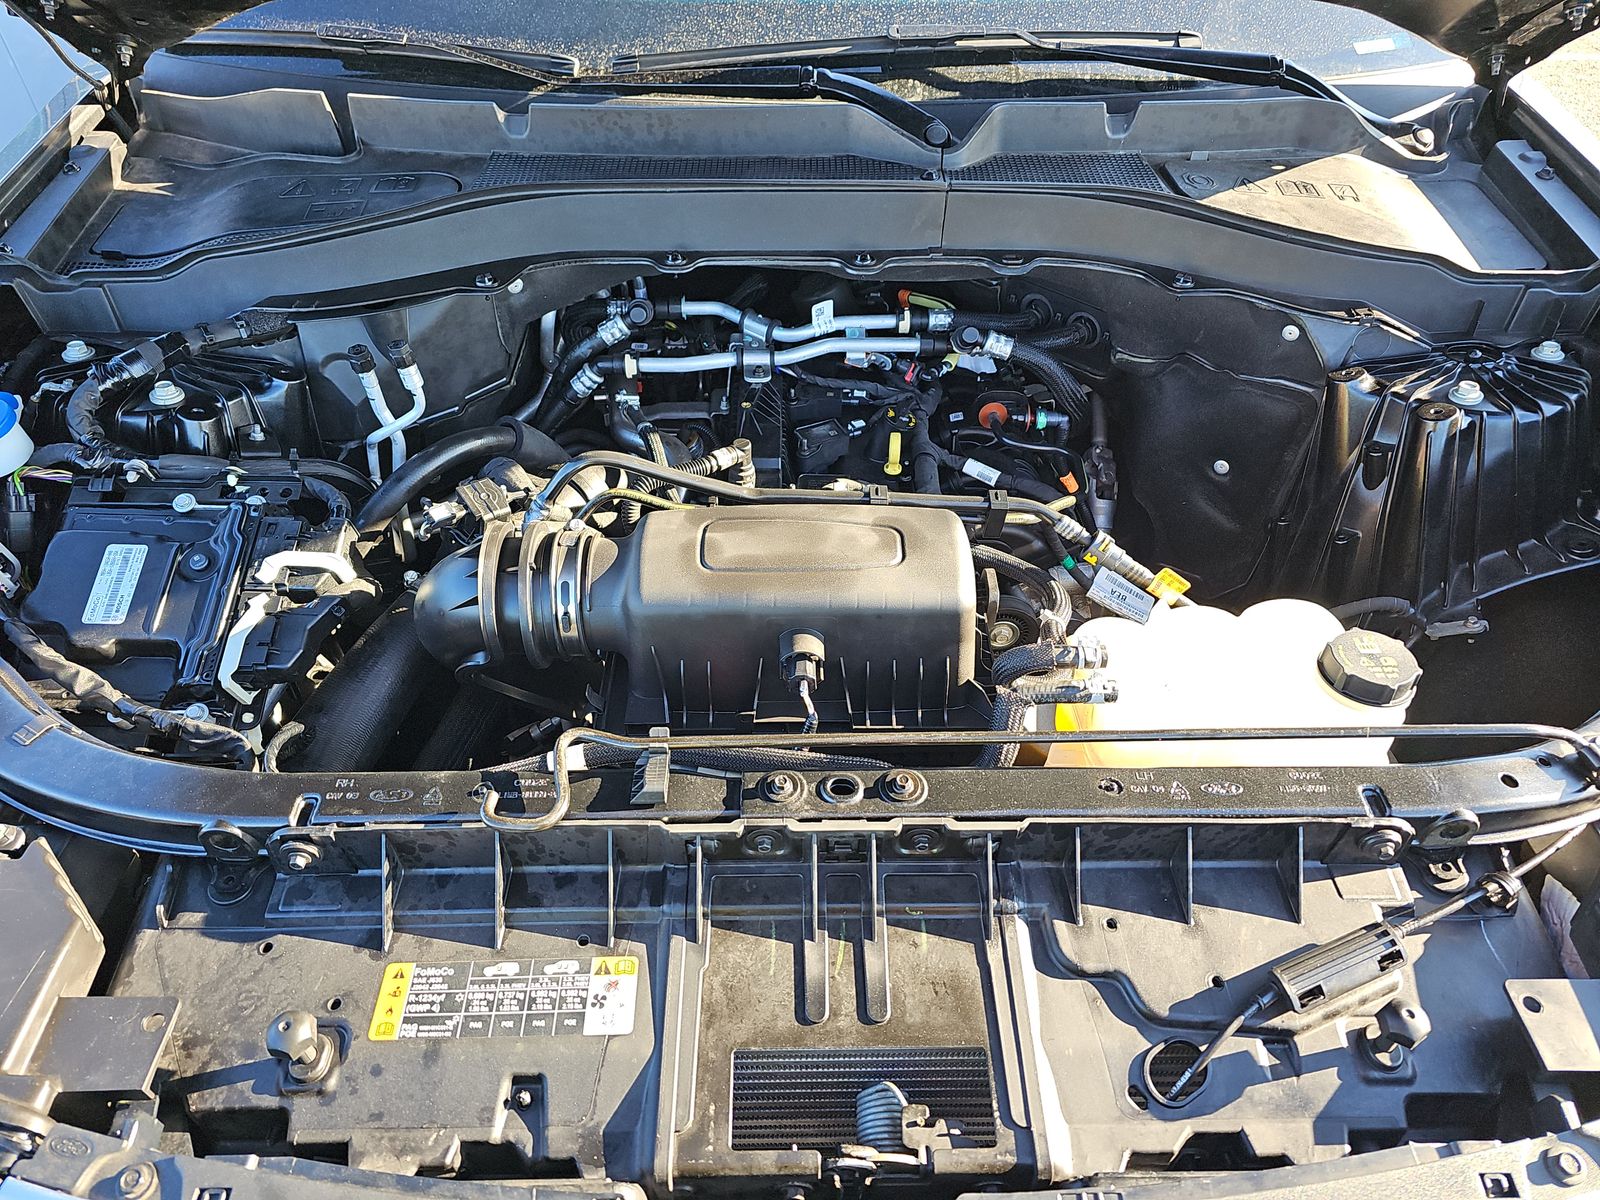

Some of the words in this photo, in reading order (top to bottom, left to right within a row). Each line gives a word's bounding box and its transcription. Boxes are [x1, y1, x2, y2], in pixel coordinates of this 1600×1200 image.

[115, 595, 124, 614] BOSCH
[414, 967, 454, 976] FoMoCo
[408, 993, 446, 1003] R-1234yf
